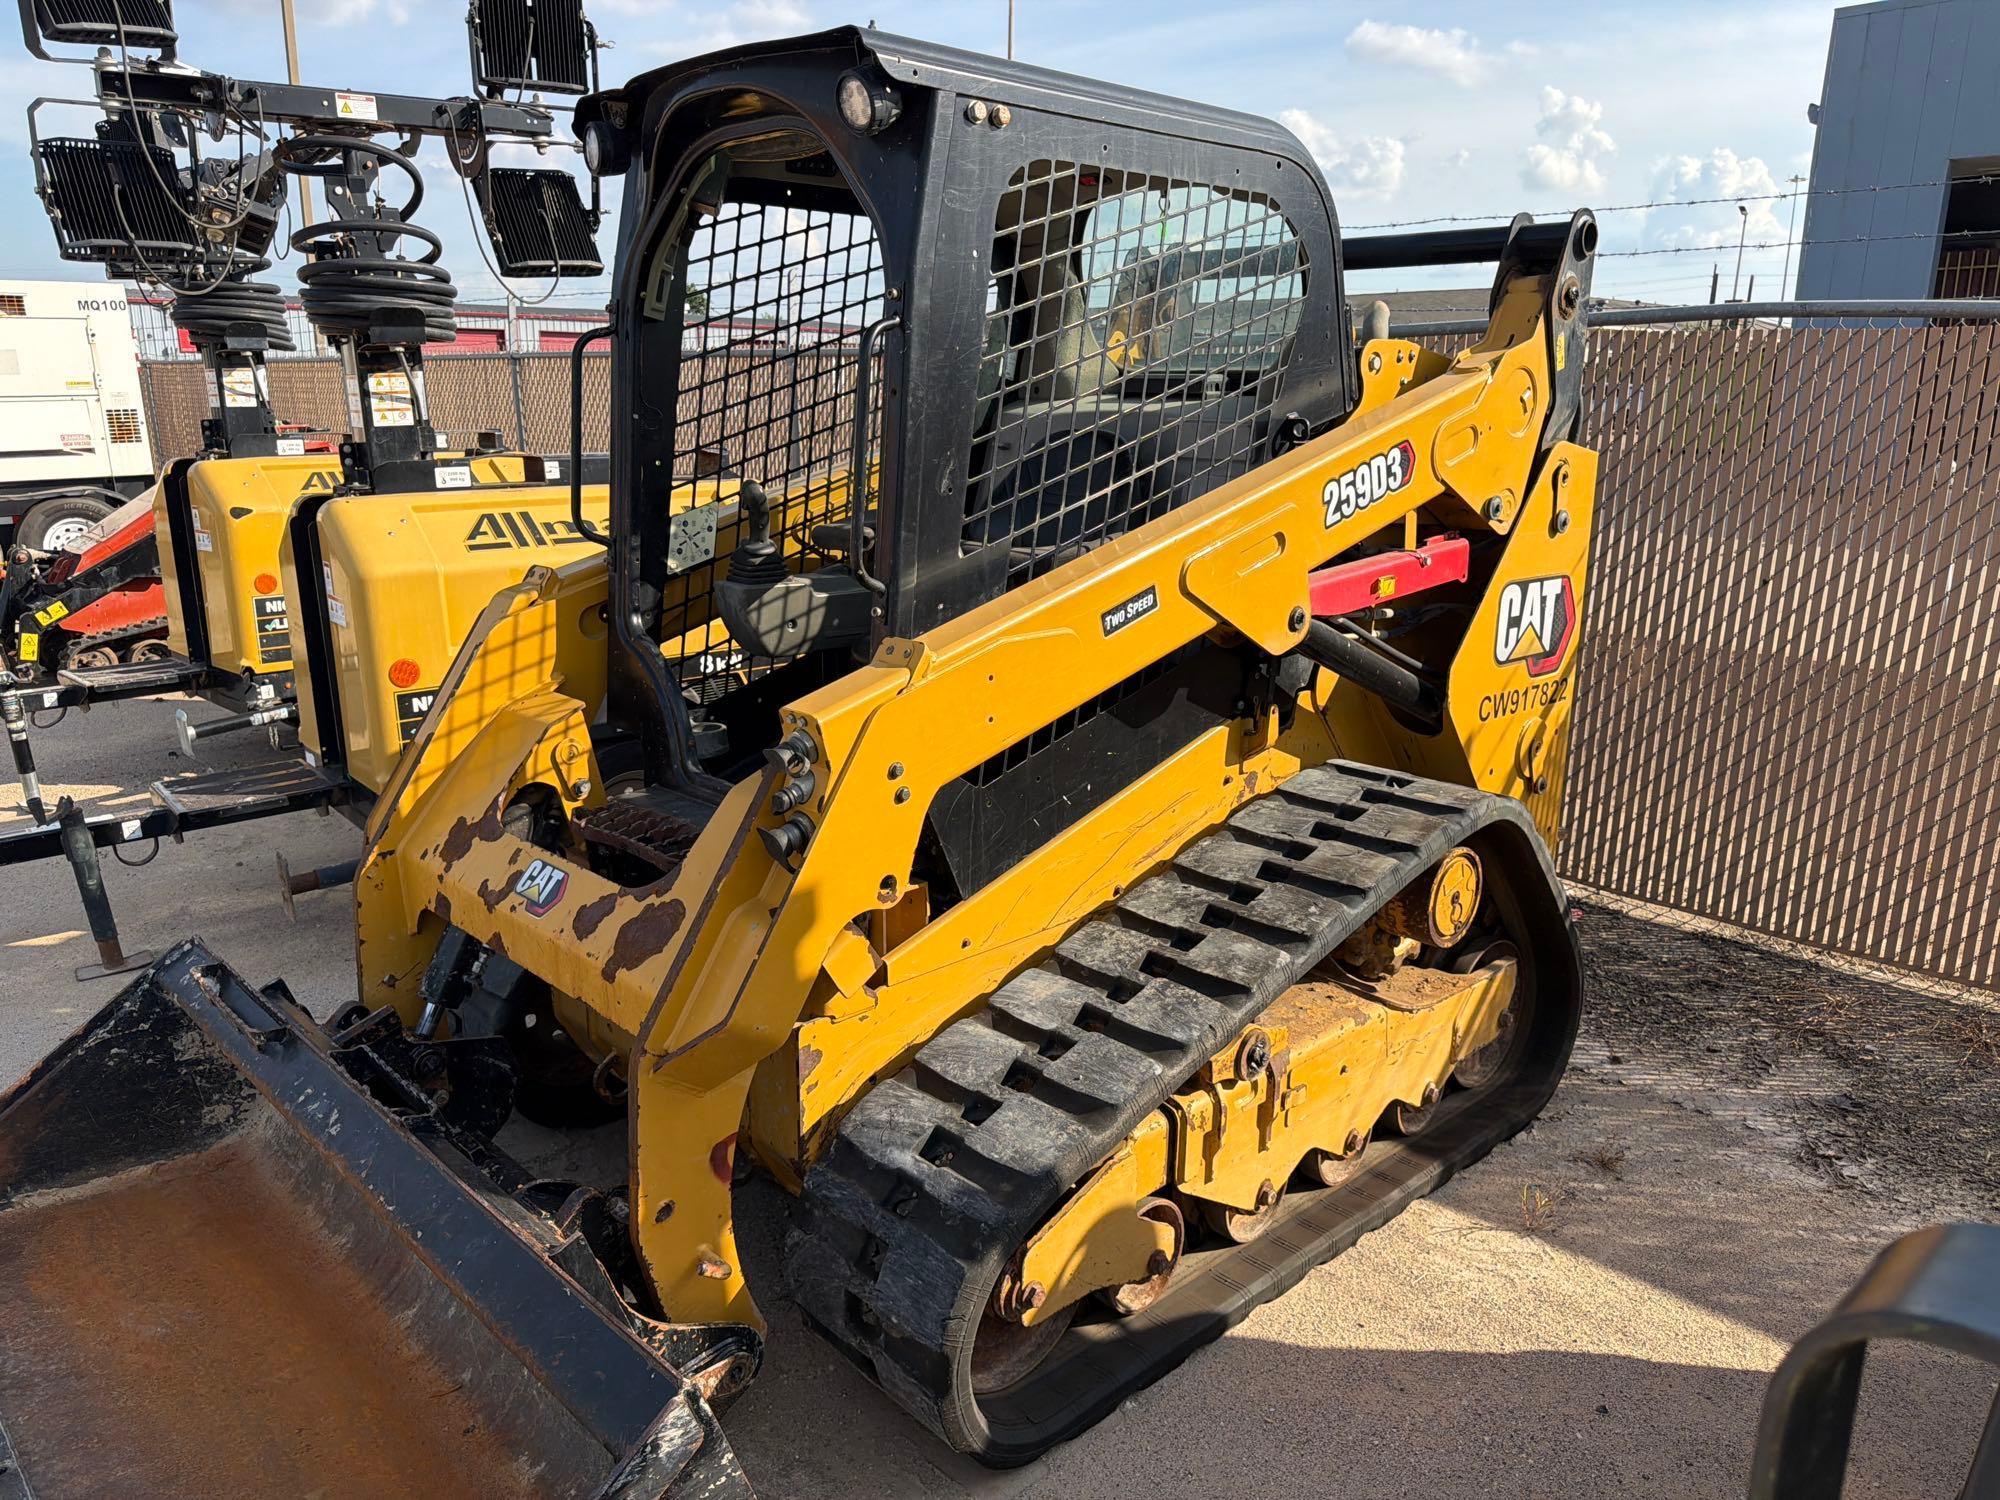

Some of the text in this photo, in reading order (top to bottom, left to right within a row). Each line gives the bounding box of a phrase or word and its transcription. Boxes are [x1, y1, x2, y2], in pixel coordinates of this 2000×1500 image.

[77, 300, 127, 312] MQ100
[1322, 446, 1404, 528] 259D3
[1126, 593, 1154, 619] SPEED
[1495, 577, 1564, 662] CAT
[1479, 677, 1569, 723] CW917822
[515, 859, 566, 905] CAT
